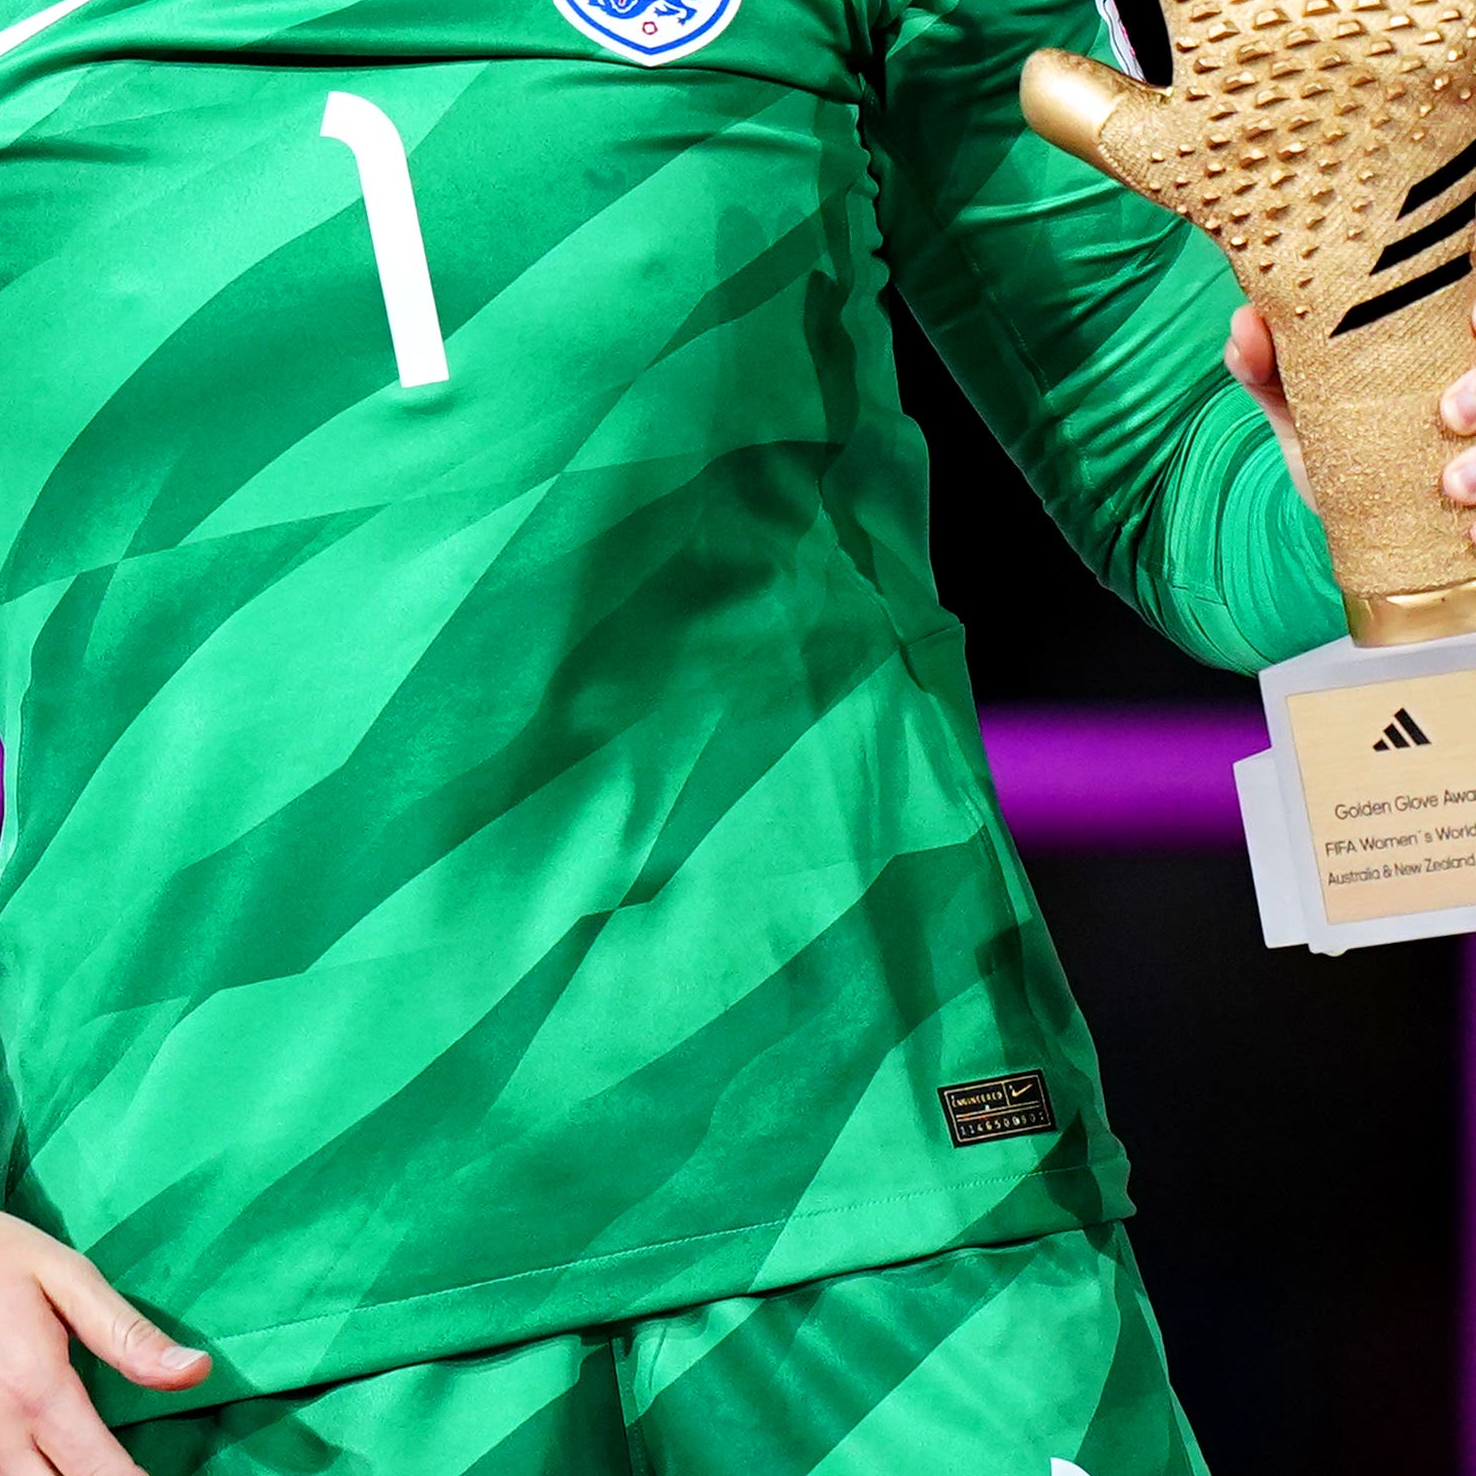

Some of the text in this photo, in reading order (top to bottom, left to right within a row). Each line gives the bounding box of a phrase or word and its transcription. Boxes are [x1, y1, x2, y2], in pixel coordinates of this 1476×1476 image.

[319, 90, 450, 389] 1
[1334, 801, 1391, 820] Golden
[1394, 795, 1438, 812] Glove
[1325, 840, 1357, 857] FIFA
[1327, 867, 1381, 886] Australia
[1382, 865, 1393, 879] &
[1394, 862, 1423, 876] New
[1425, 855, 1475, 873] Zealand
